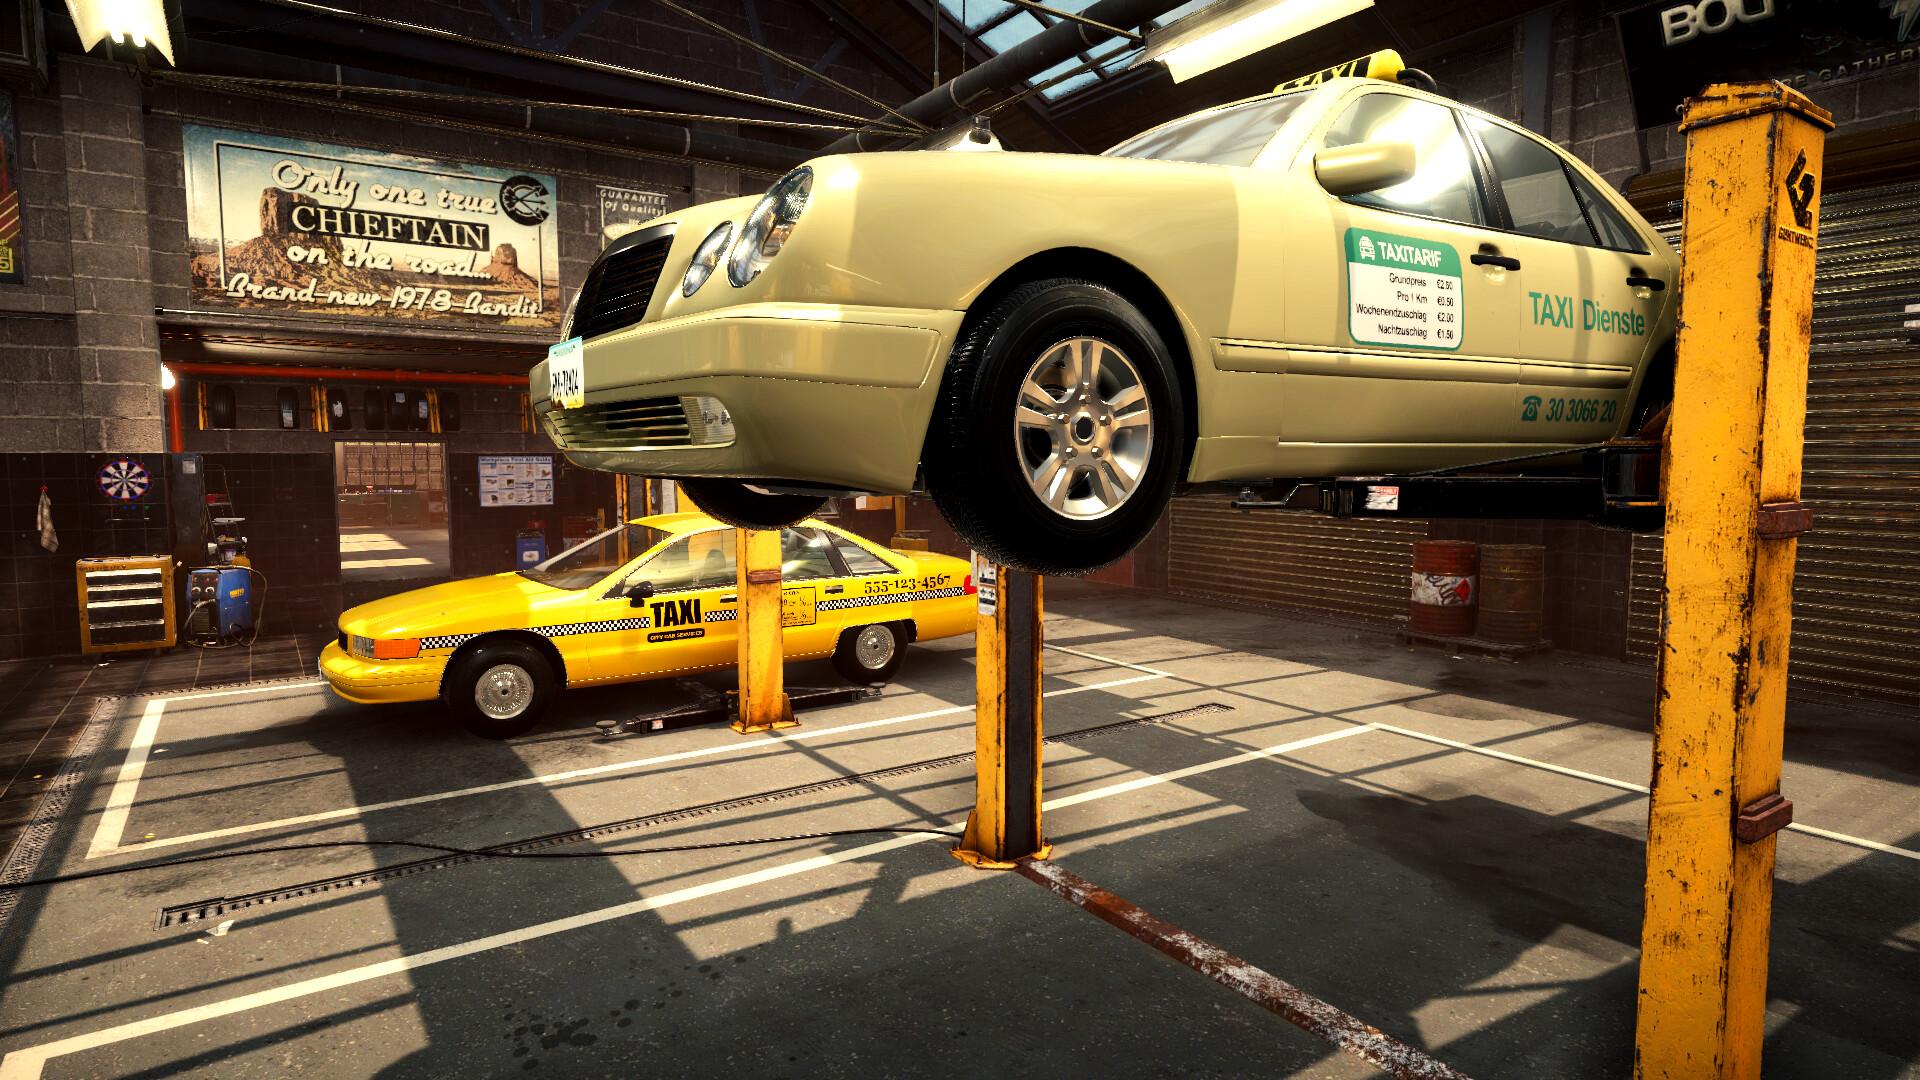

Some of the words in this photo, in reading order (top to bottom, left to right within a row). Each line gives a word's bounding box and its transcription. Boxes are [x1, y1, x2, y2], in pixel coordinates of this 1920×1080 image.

[272, 159, 359, 209] Only
[369, 183, 426, 206] one
[436, 187, 498, 214] true
[600, 189, 666, 205] GUARANTEE
[291, 206, 487, 249] CHIEFTAIN
[286, 245, 328, 265] on
[342, 239, 393, 270] the
[405, 251, 493, 280] road...
[1377, 241, 1442, 268] TAXITARIF
[1389, 273, 1427, 287] Grundpreis
[390, 285, 452, 312] 1978
[463, 291, 540, 319] Bandit
[1397, 290, 1409, 301] Pro
[1416, 293, 1428, 304] Km
[1356, 303, 1427, 323] Wochenendzuschlag
[1528, 291, 1573, 328] TAXI
[1582, 298, 1645, 336] Dienste
[1378, 323, 1428, 339] Nachtzuschlag
[1437, 328, 1454, 340] €1.50
[1546, 397, 1564, 422] 30
[1566, 398, 1599, 423] 3066
[1601, 399, 1617, 423] 20
[864, 573, 951, 594] 555-123-4567
[650, 599, 702, 628] TAXI
